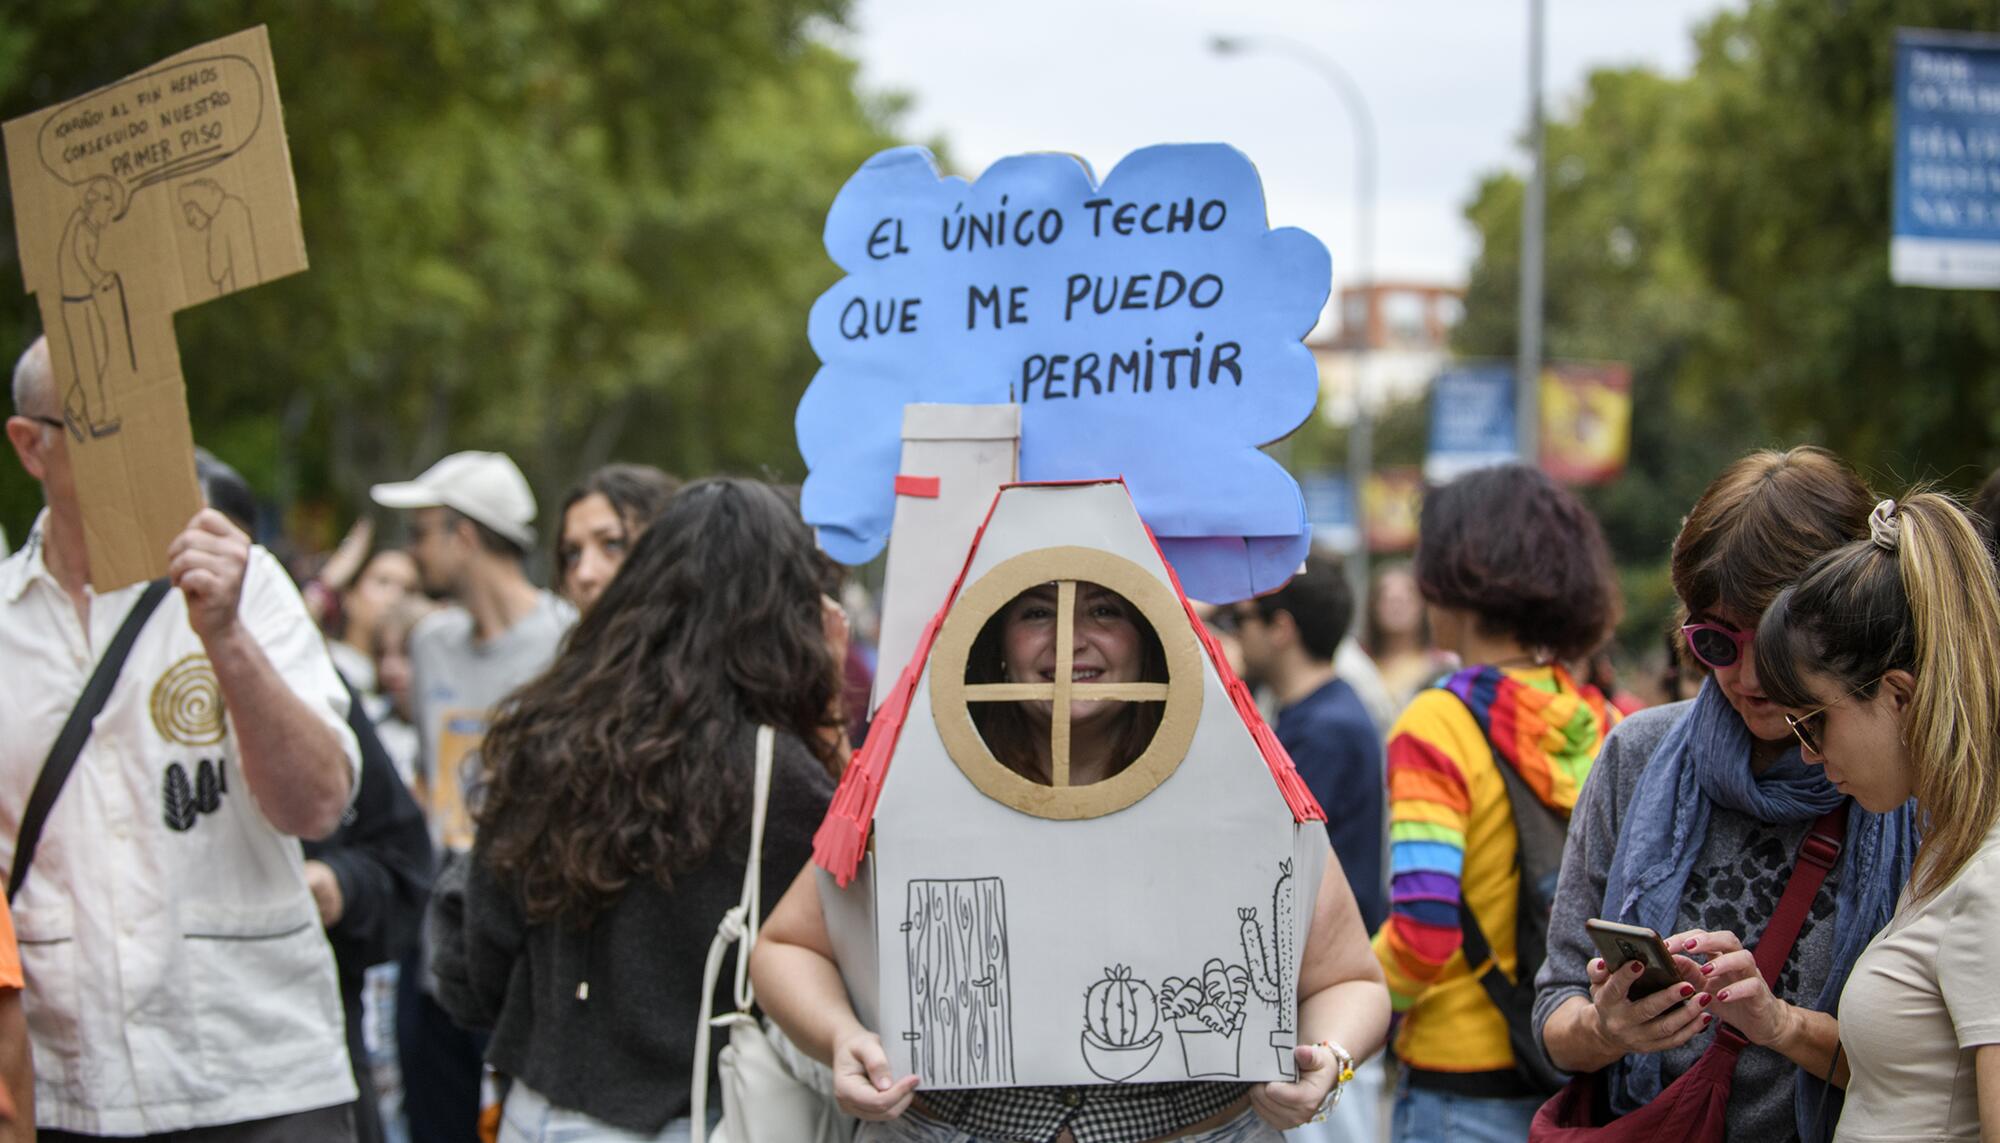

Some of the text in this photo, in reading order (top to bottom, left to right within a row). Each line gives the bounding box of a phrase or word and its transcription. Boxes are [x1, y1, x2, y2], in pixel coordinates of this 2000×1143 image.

[110, 102, 129, 117] AL
[137, 87, 162, 107] FIN
[169, 67, 218, 95] HEMOS
[62, 91, 231, 164] CONSEGUIDO NUESTRO
[111, 120, 222, 176] PRIMER PISO
[866, 217, 911, 259] EL
[1084, 198, 1227, 237] TECHO
[839, 269, 1225, 340] QUE ME PUEDO
